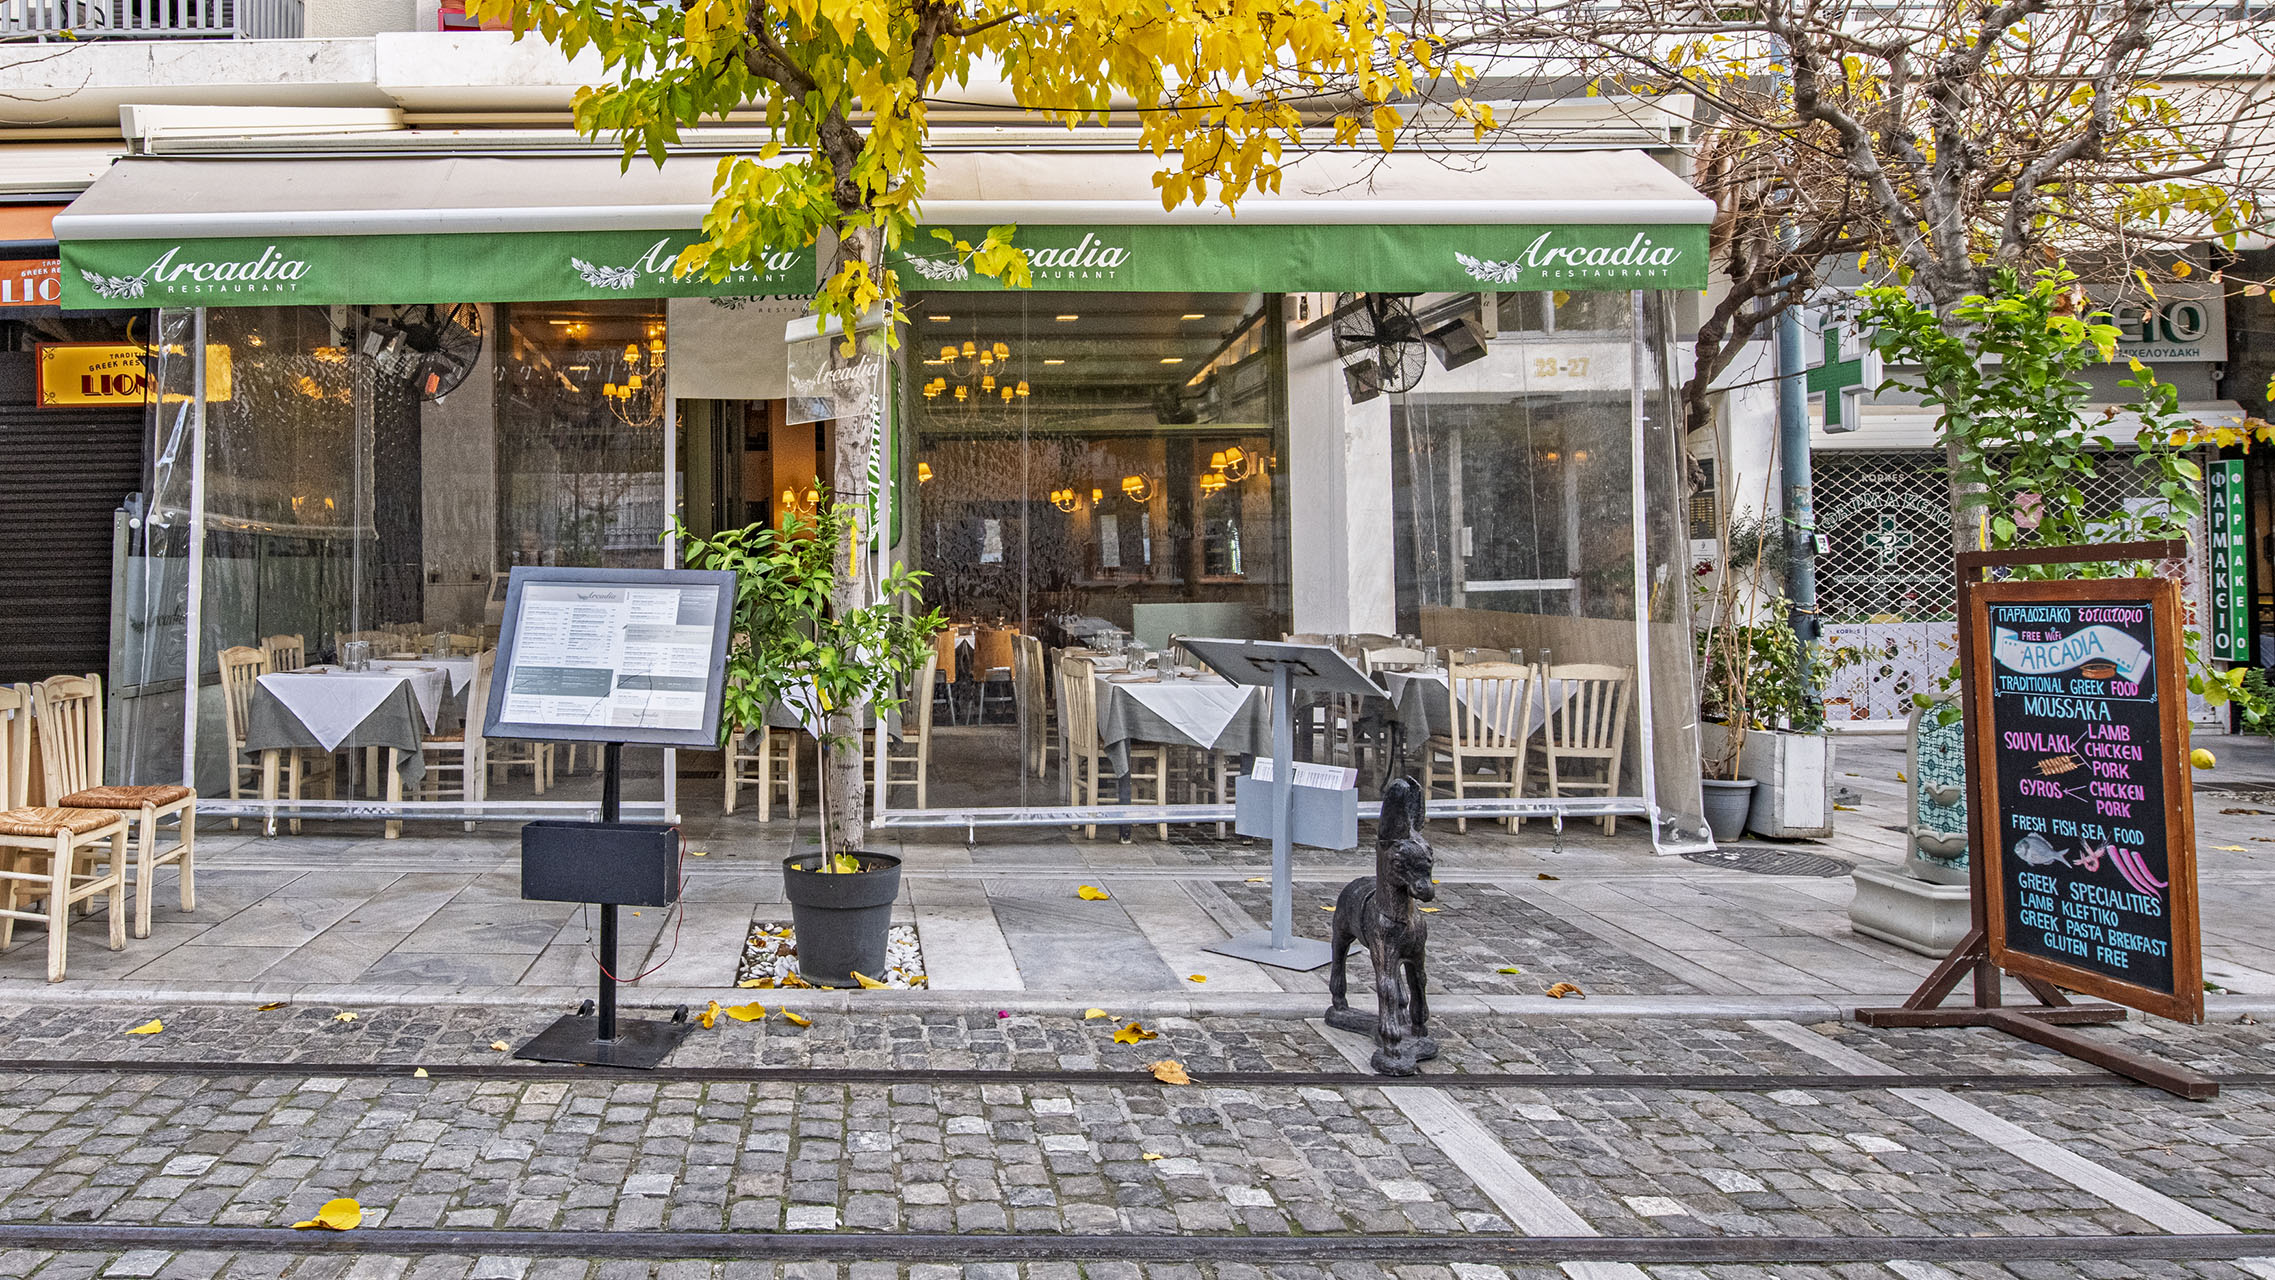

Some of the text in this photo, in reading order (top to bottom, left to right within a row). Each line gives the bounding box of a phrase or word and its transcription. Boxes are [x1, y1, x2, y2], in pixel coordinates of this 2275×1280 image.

[633, 237, 801, 273] Aria
[965, 232, 1131, 267] cadia
[1516, 231, 1682, 267] Arcadia
[21, 267, 48, 277] GREEK
[141, 245, 312, 282] Arcadia
[988, 270, 1115, 279] TAURANT
[1542, 269, 1668, 278] RESTAURANT
[168, 284, 296, 293] RESTAURANT
[659, 274, 785, 284] RESTURANT
[89, 361, 118, 372] GREEK
[811, 354, 881, 385] Arcadia
[1535, 357, 1590, 378] 23-27
[2211, 472, 2230, 649] ΦΑΡΜΑΚΕΙΟ
[2231, 473, 2246, 649] ΦΑΡΜΑΚΕΙΟ
[1998, 607, 2072, 623] ΠΑΡΑΔΟΣΙΑΚΟ
[2022, 631, 2042, 641] FREE
[2020, 630, 2105, 670] ARCADIA
[1999, 676, 2139, 697] TRADITIONAL GREEK FOOD
[2024, 696, 2112, 722] MOUSSAKA
[2004, 731, 2071, 754] SOUVLAKI
[2088, 723, 2131, 742] LAMB
[2084, 742, 2143, 761] CHICKEN
[2092, 760, 2131, 780] PORK
[2019, 778, 2145, 801] GYROS CHICKEN
[2096, 800, 2132, 819] PORK
[2012, 814, 2145, 846] FRESH FISH SEA FOOD
[2018, 871, 2161, 917] GREEK SPECIALITIES
[2020, 890, 2119, 927] LAMB KLEFTIKO
[2020, 909, 2168, 957] GREEK PASTA BREKFAST
[2043, 932, 2129, 969] GLUTEN FREE
